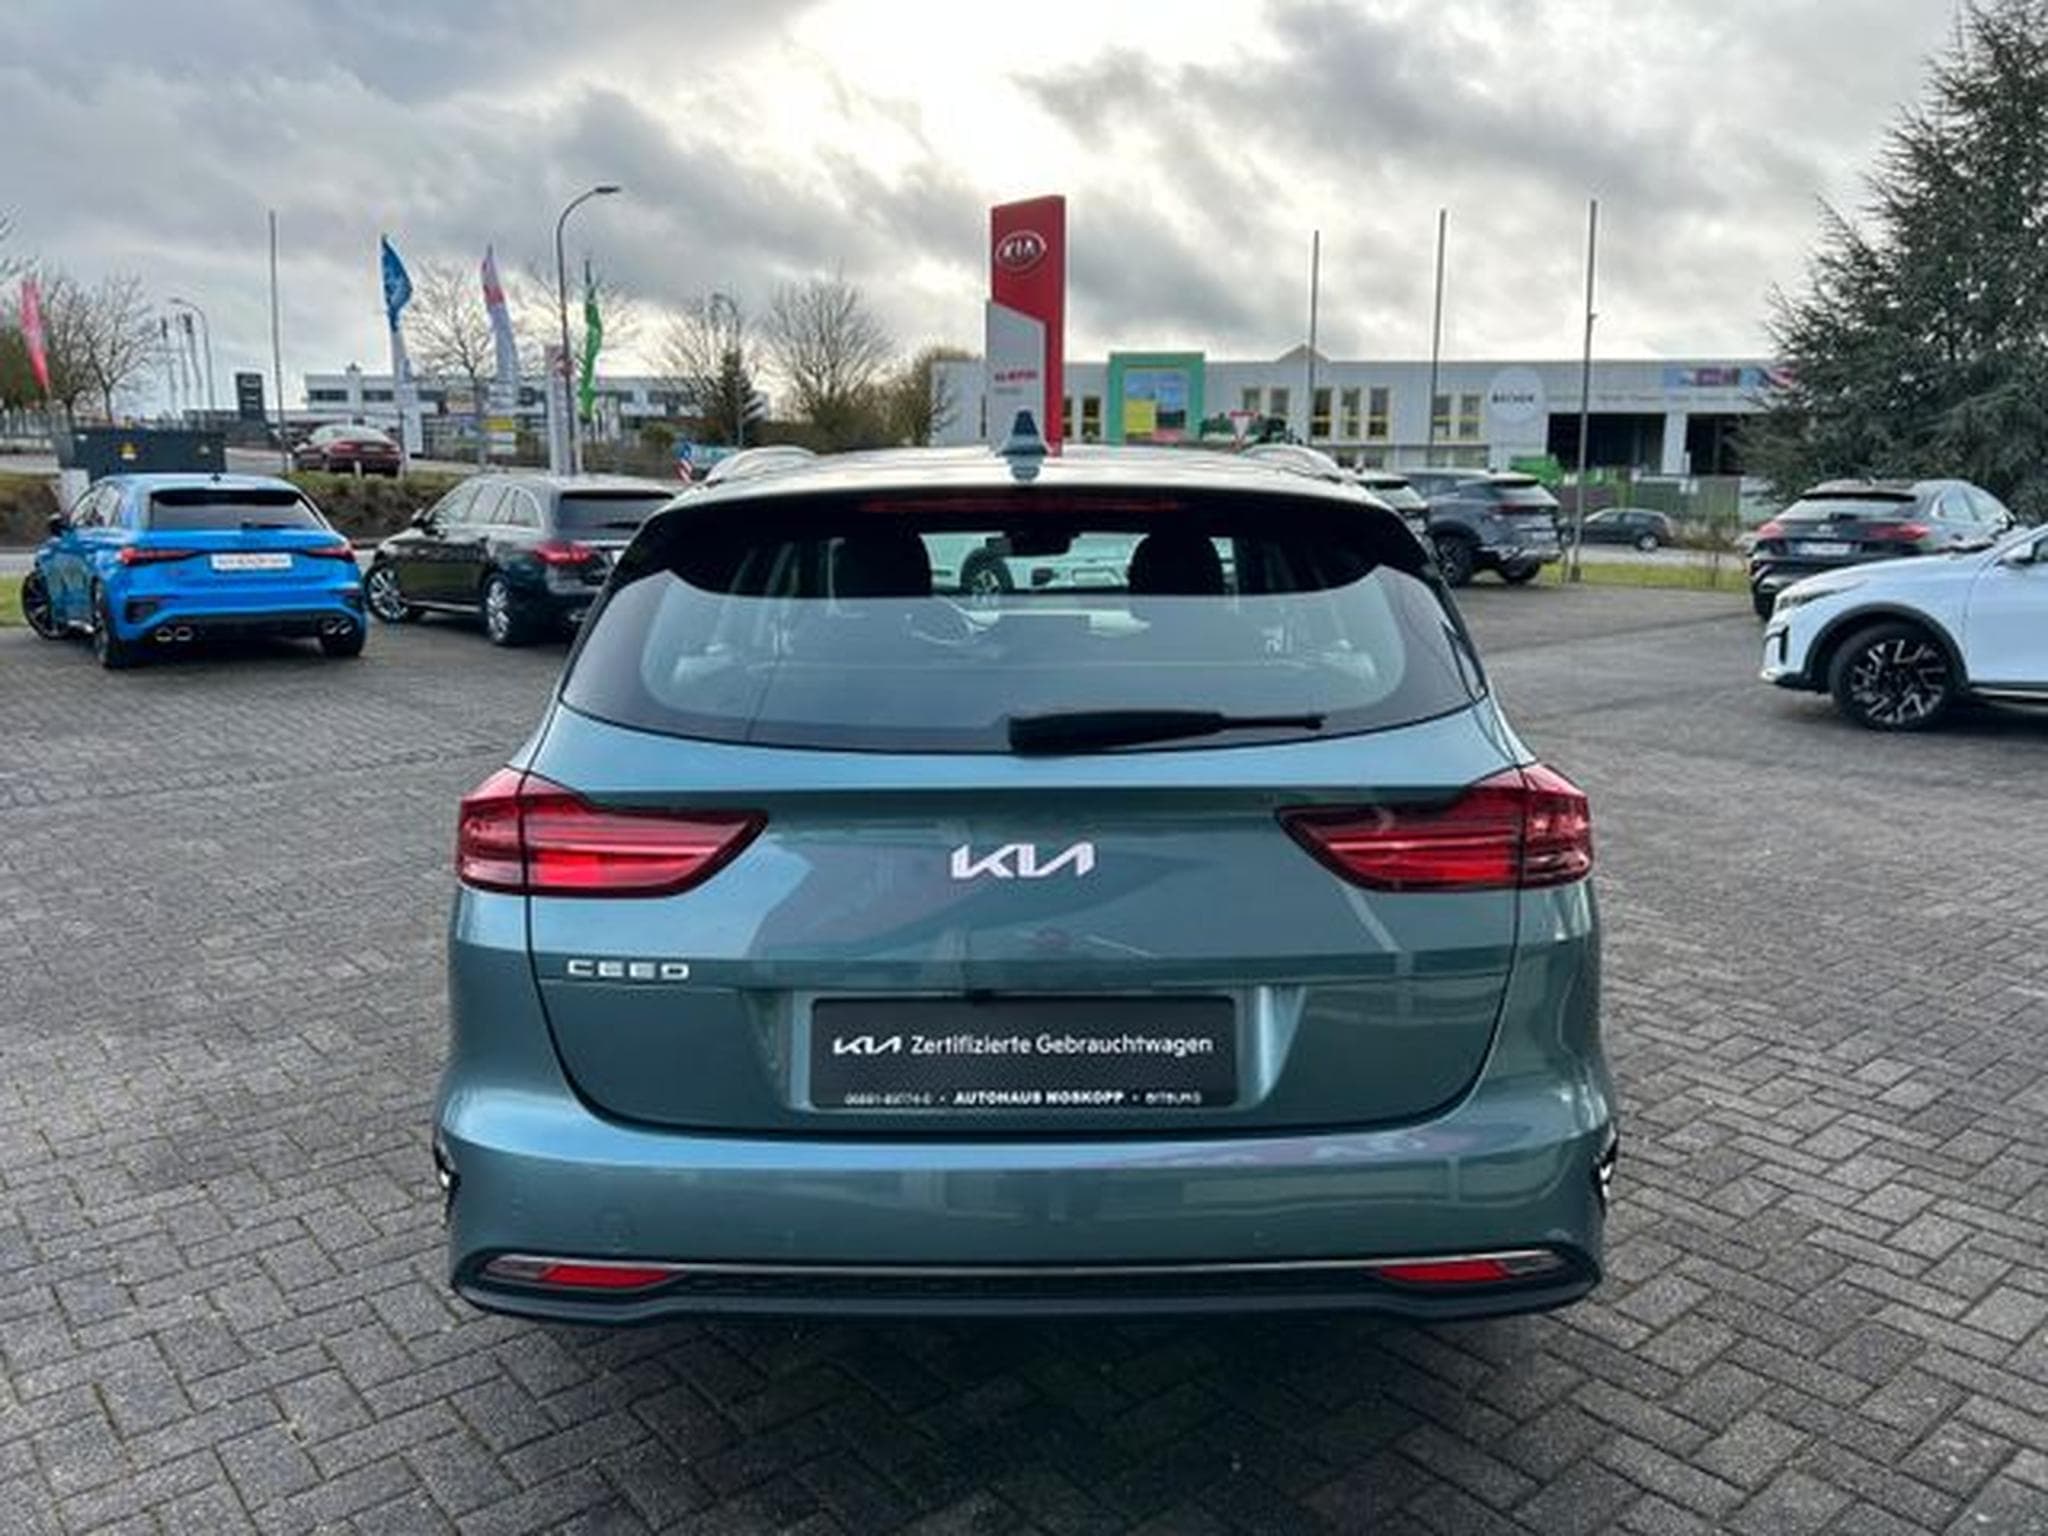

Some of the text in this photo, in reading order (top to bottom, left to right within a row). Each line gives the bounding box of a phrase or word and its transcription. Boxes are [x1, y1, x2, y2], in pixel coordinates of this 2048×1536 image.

[1002, 239, 1037, 259] KIA
[951, 841, 1095, 879] KIA
[568, 959, 690, 981] CEED
[910, 1034, 1032, 1055] Zertifizierte
[1036, 1032, 1214, 1058] Gebrauchtwagen
[953, 1090, 1042, 1105] AUTOHAUS
